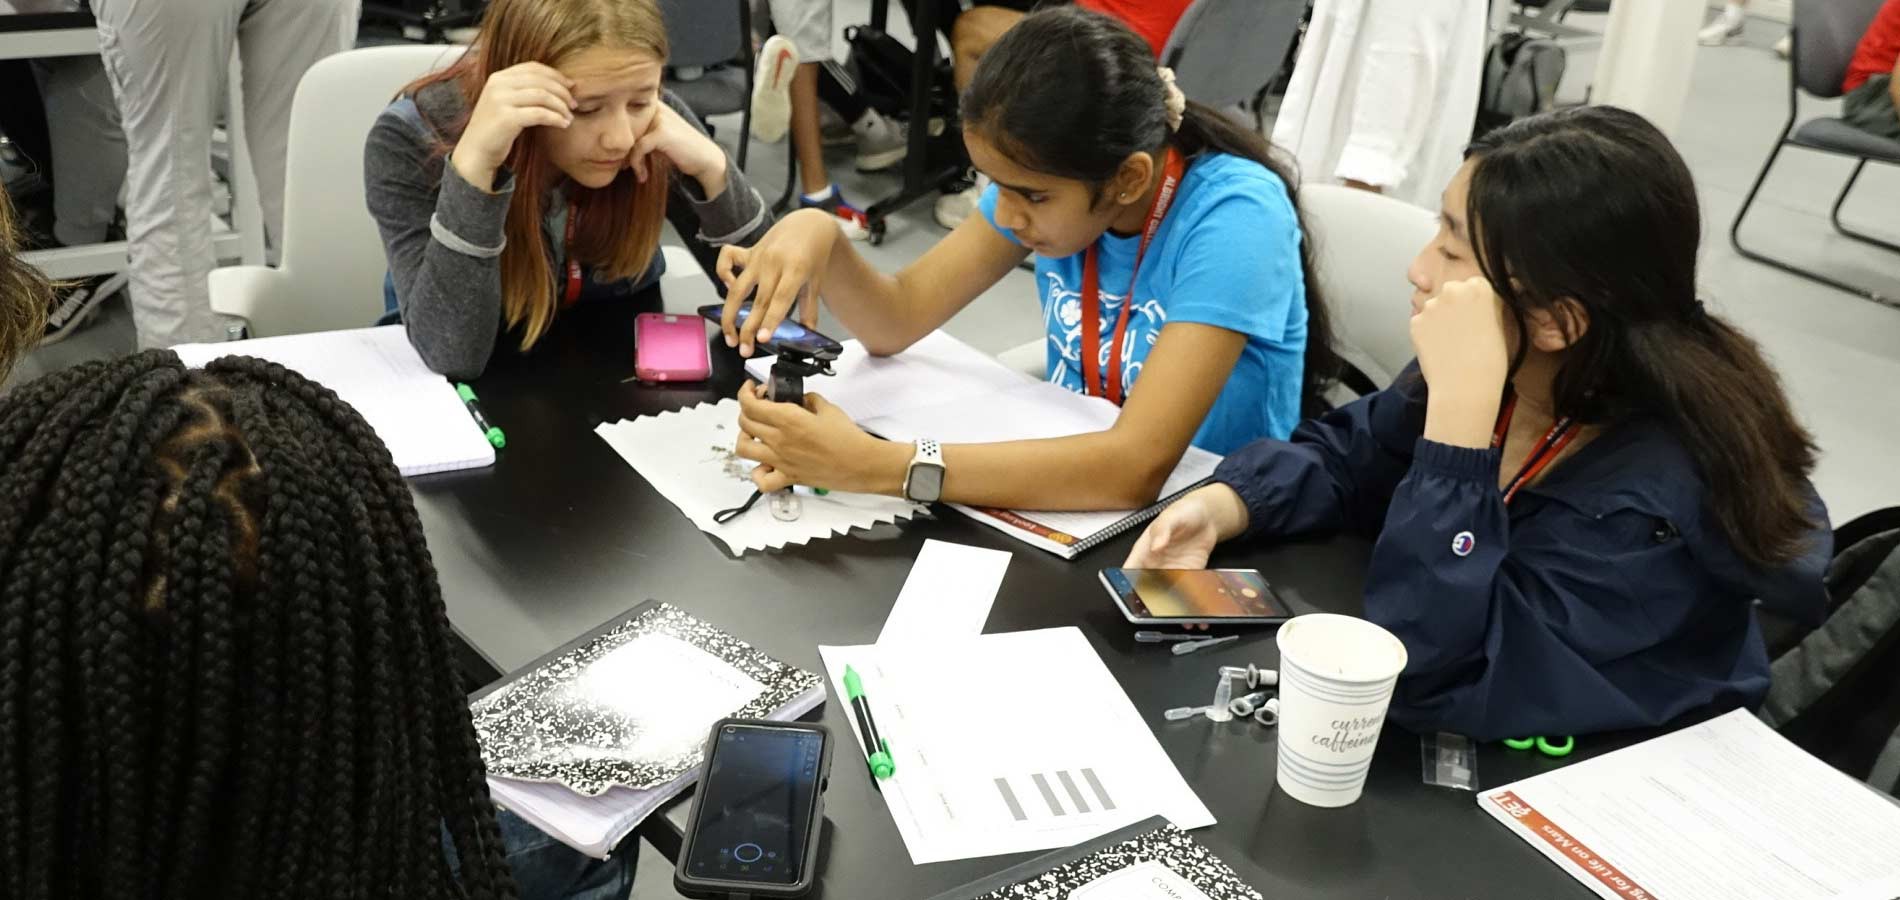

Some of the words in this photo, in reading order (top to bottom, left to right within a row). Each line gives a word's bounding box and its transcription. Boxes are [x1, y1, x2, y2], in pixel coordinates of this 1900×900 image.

[1541, 825, 1574, 848] Mars
[1571, 846, 1590, 860] on
[1587, 858, 1614, 877] Life
[1609, 876, 1631, 891] for
